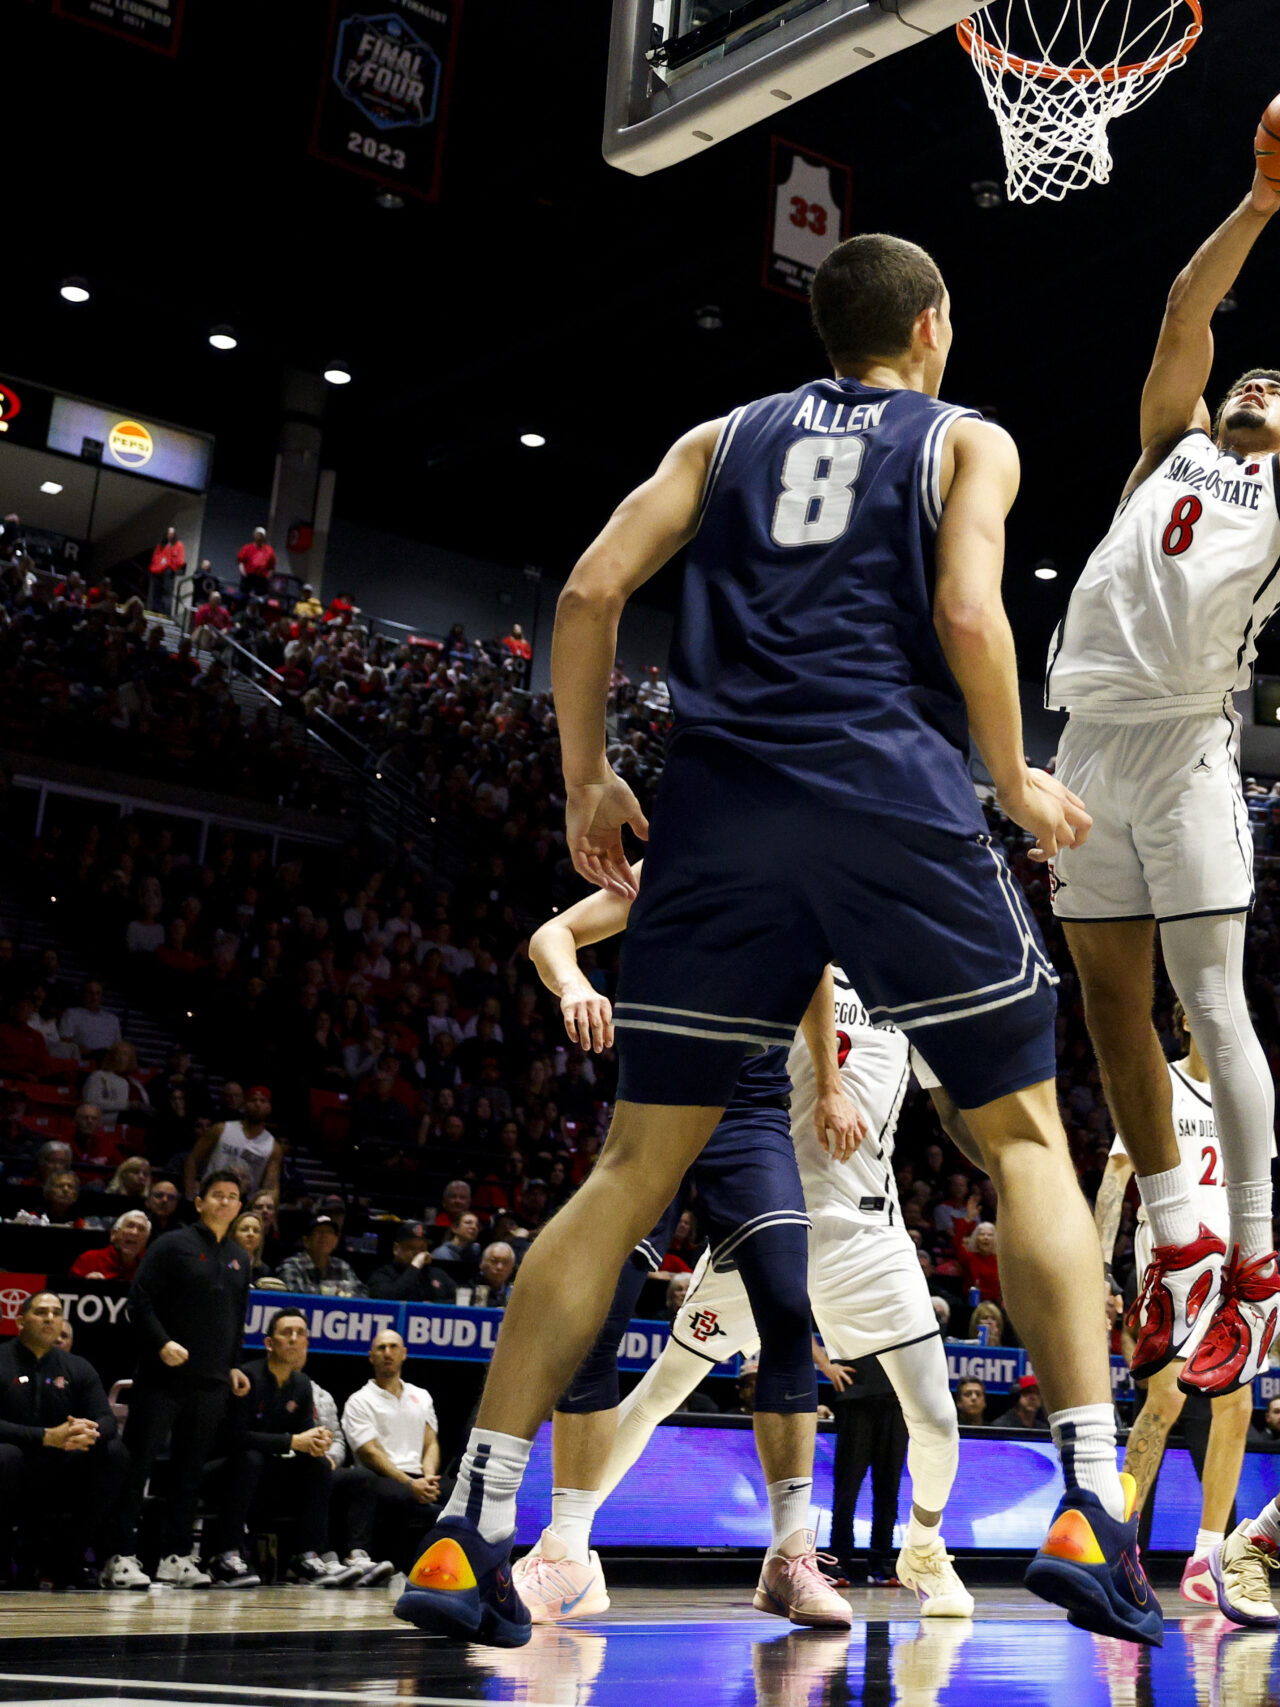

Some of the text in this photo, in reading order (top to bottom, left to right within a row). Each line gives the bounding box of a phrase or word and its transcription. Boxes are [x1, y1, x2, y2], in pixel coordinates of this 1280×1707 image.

[357, 32, 423, 80] FINAL
[359, 59, 426, 104] FOUR
[346, 130, 408, 171] 2023
[790, 196, 827, 236] 33
[792, 394, 891, 434] ALLEN
[112, 436, 150, 453] PEPSI
[770, 436, 866, 548] 8
[1163, 455, 1196, 483] SAN
[1212, 478, 1263, 511] STATE
[1161, 494, 1203, 556] 8
[1178, 1119, 1196, 1137] SAN
[408, 1316, 478, 1348] BUD
[948, 1356, 1017, 1383] LIGHT
